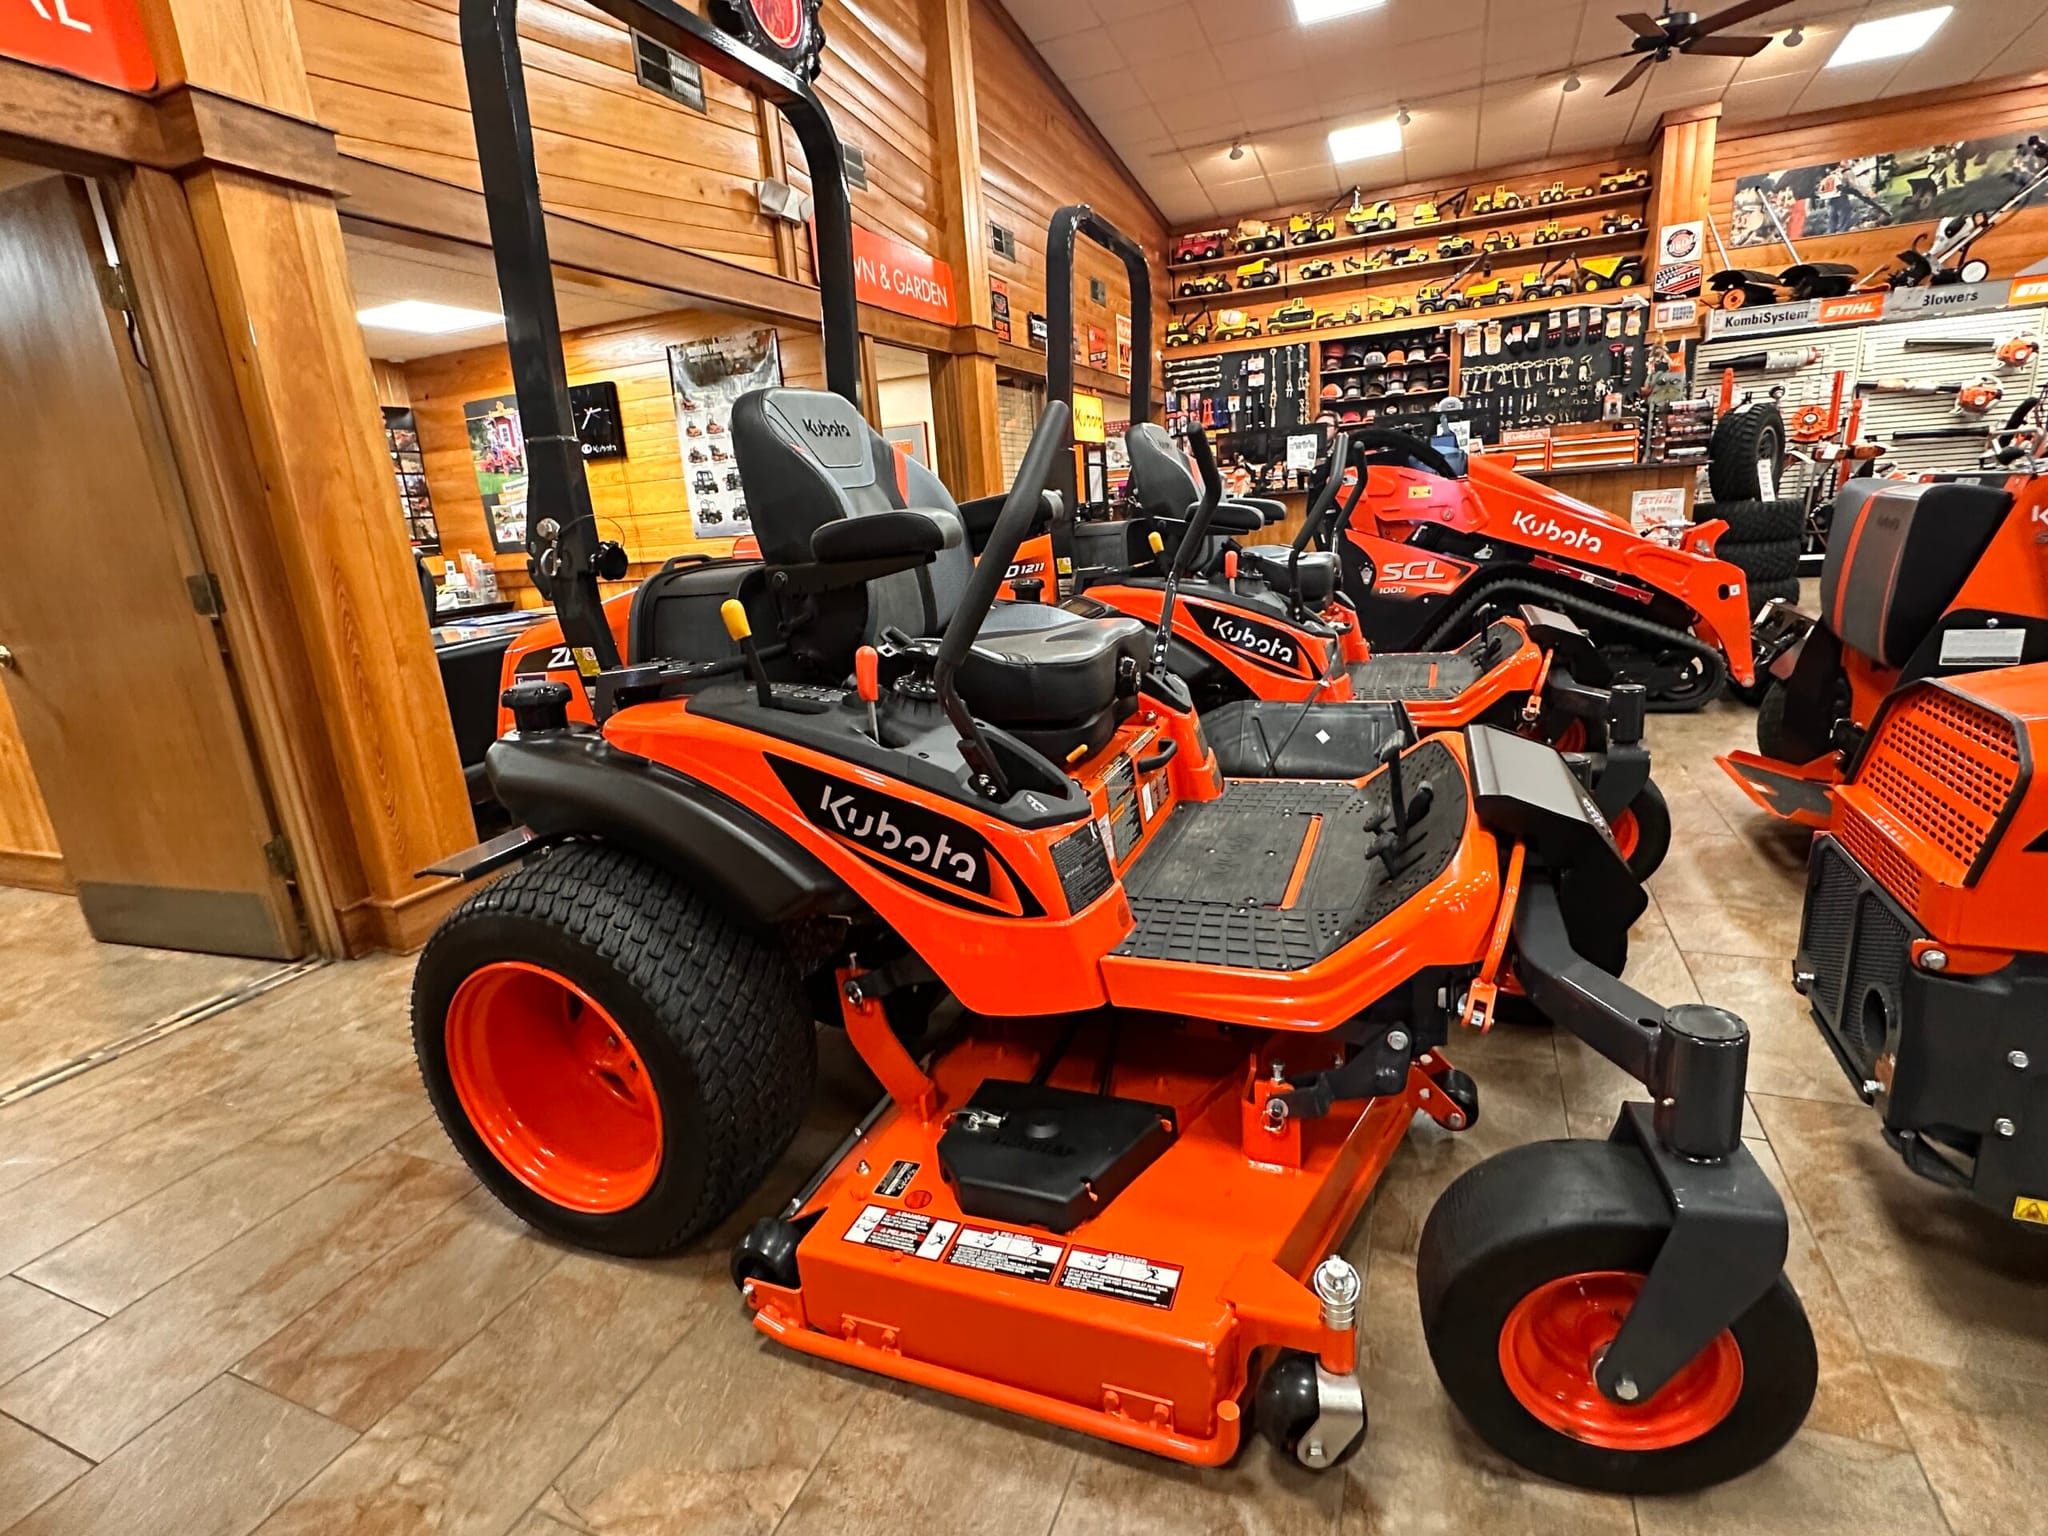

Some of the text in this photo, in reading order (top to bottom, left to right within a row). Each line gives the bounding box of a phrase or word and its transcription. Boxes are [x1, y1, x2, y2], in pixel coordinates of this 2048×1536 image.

[880, 263, 891, 290] &
[893, 268, 948, 308] GARDEN
[1725, 310, 1809, 328] KombiSystem
[1824, 302, 1876, 318] STIHL
[801, 418, 851, 437] Kubota
[1511, 509, 1602, 553] Kubota
[1379, 561, 1446, 581] SCL
[1379, 586, 1406, 594] 1000
[1212, 616, 1293, 663] Kubota
[819, 784, 977, 883] Kubota
